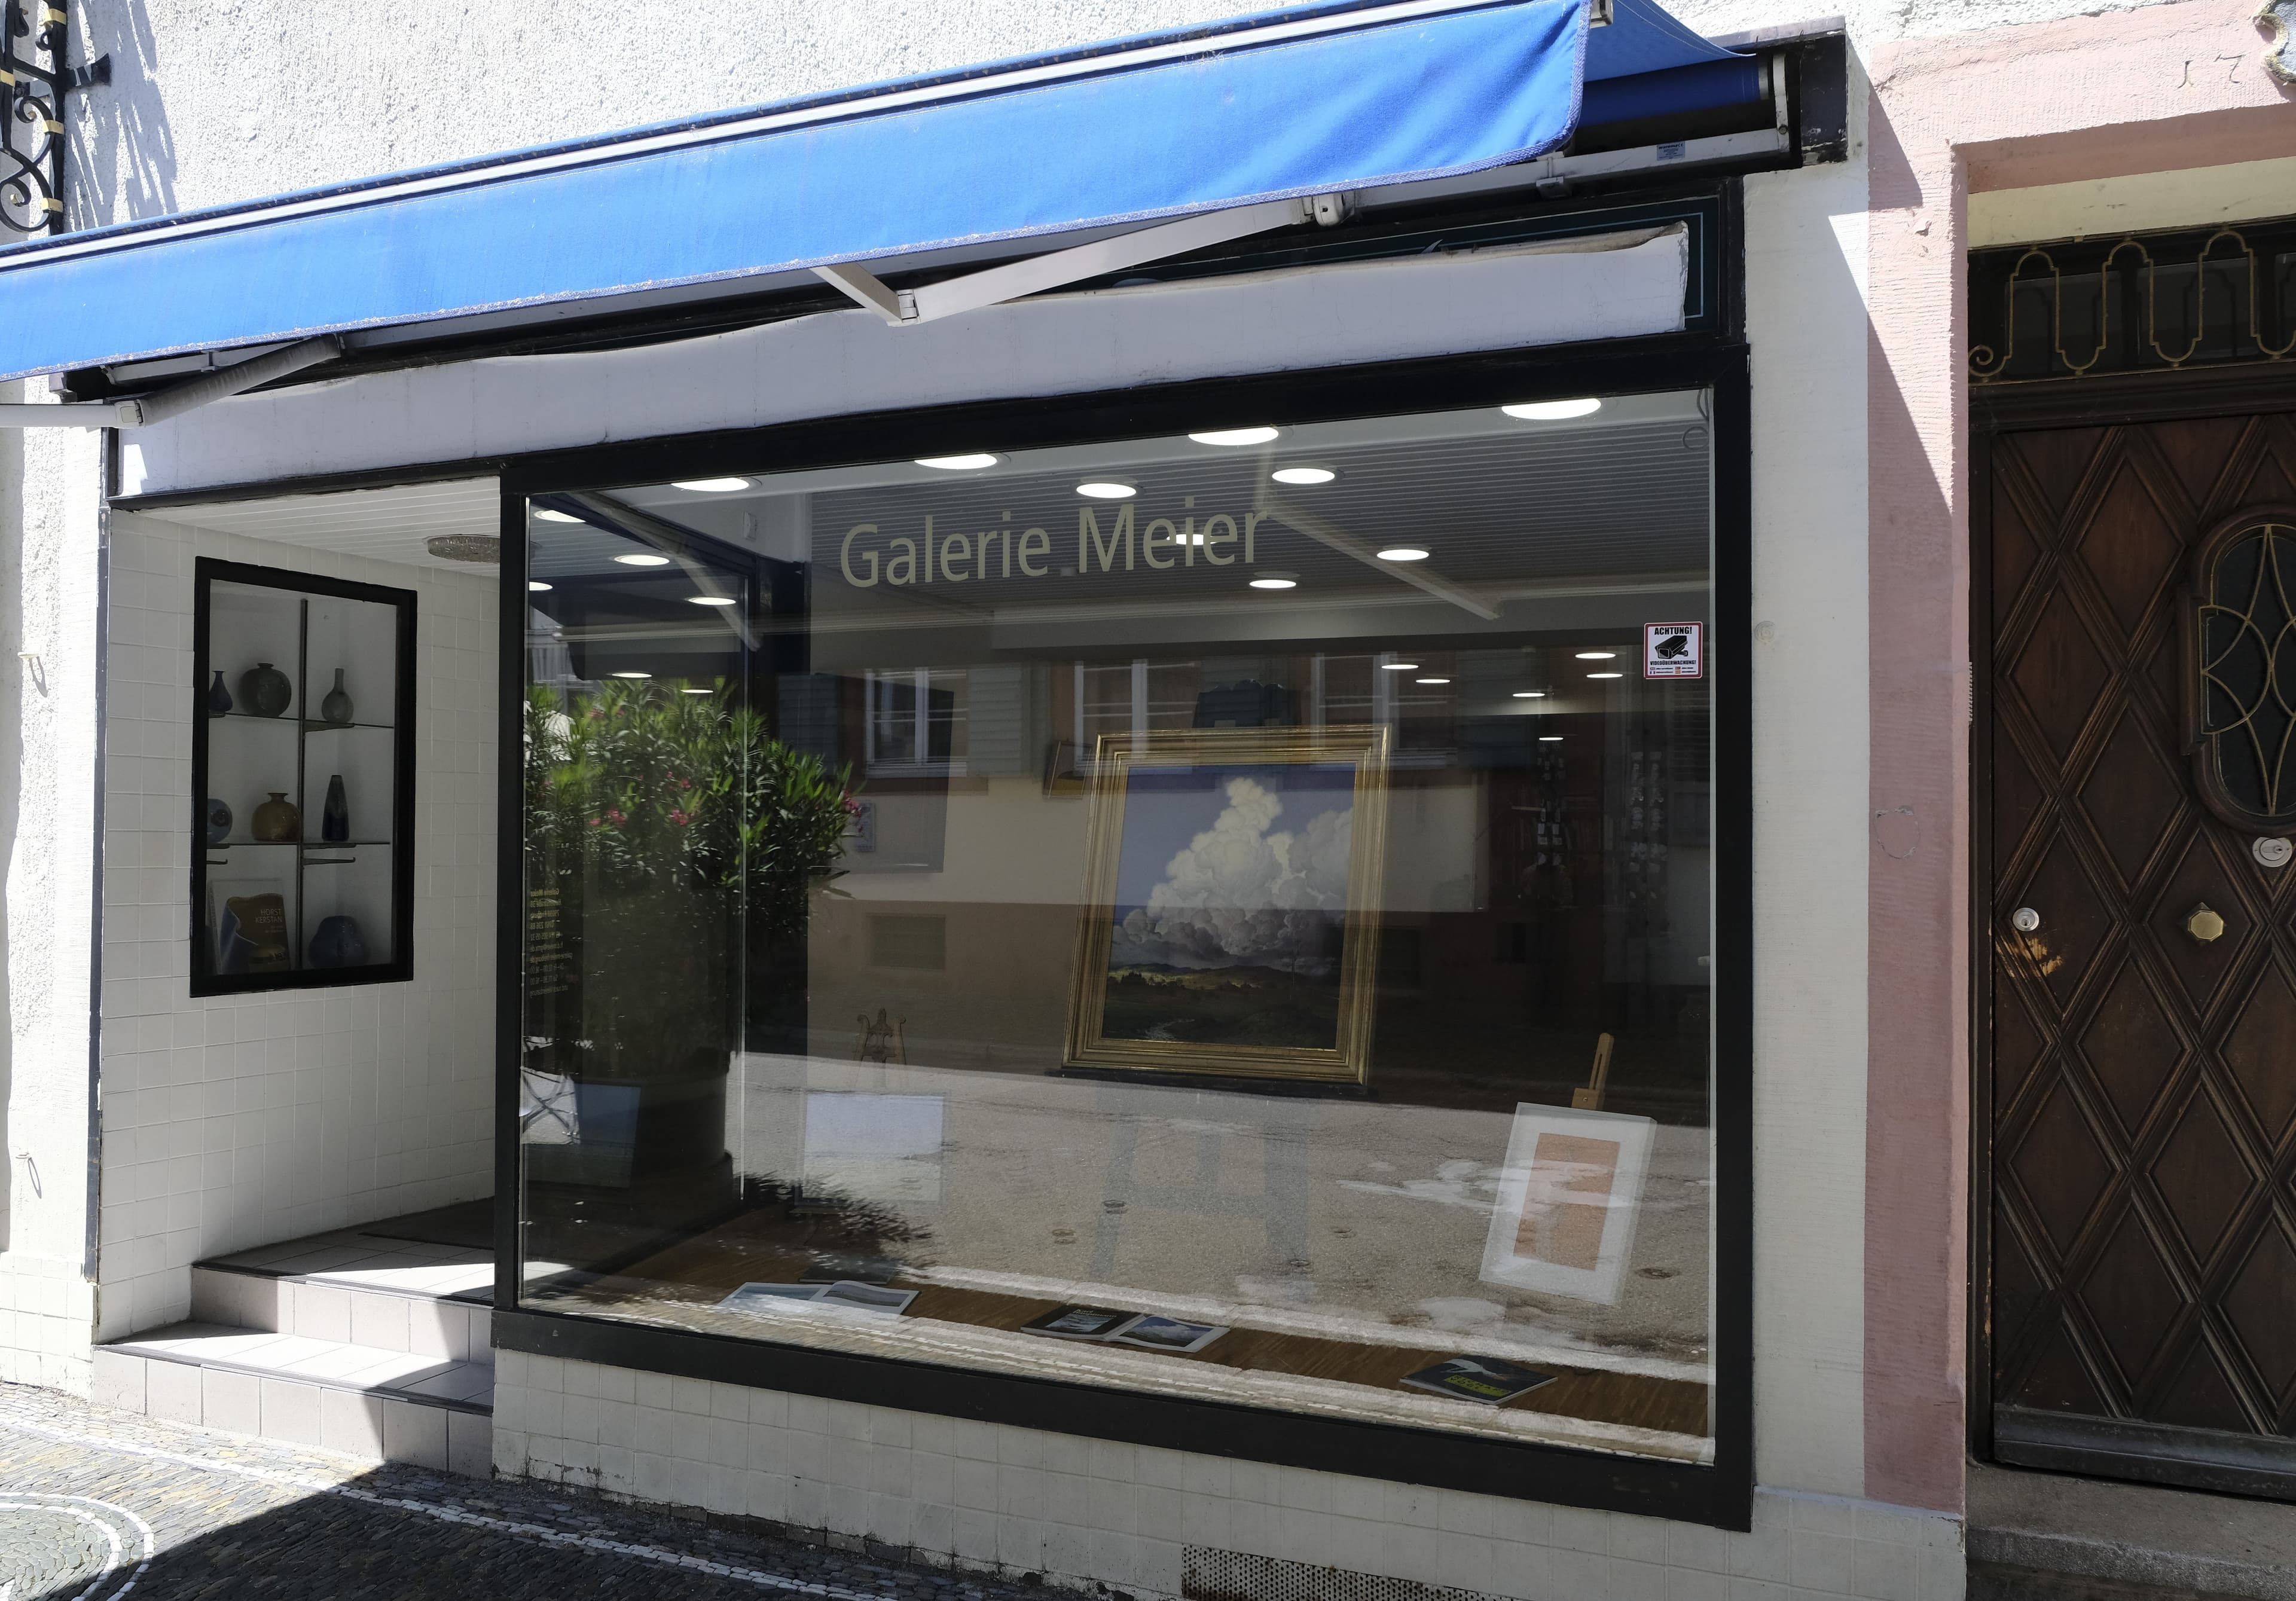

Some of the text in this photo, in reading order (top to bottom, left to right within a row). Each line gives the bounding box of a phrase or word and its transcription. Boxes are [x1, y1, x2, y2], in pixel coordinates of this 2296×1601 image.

[840, 496, 1268, 588] Galerie Meier
[1654, 627, 1692, 635] ACHTUNG!
